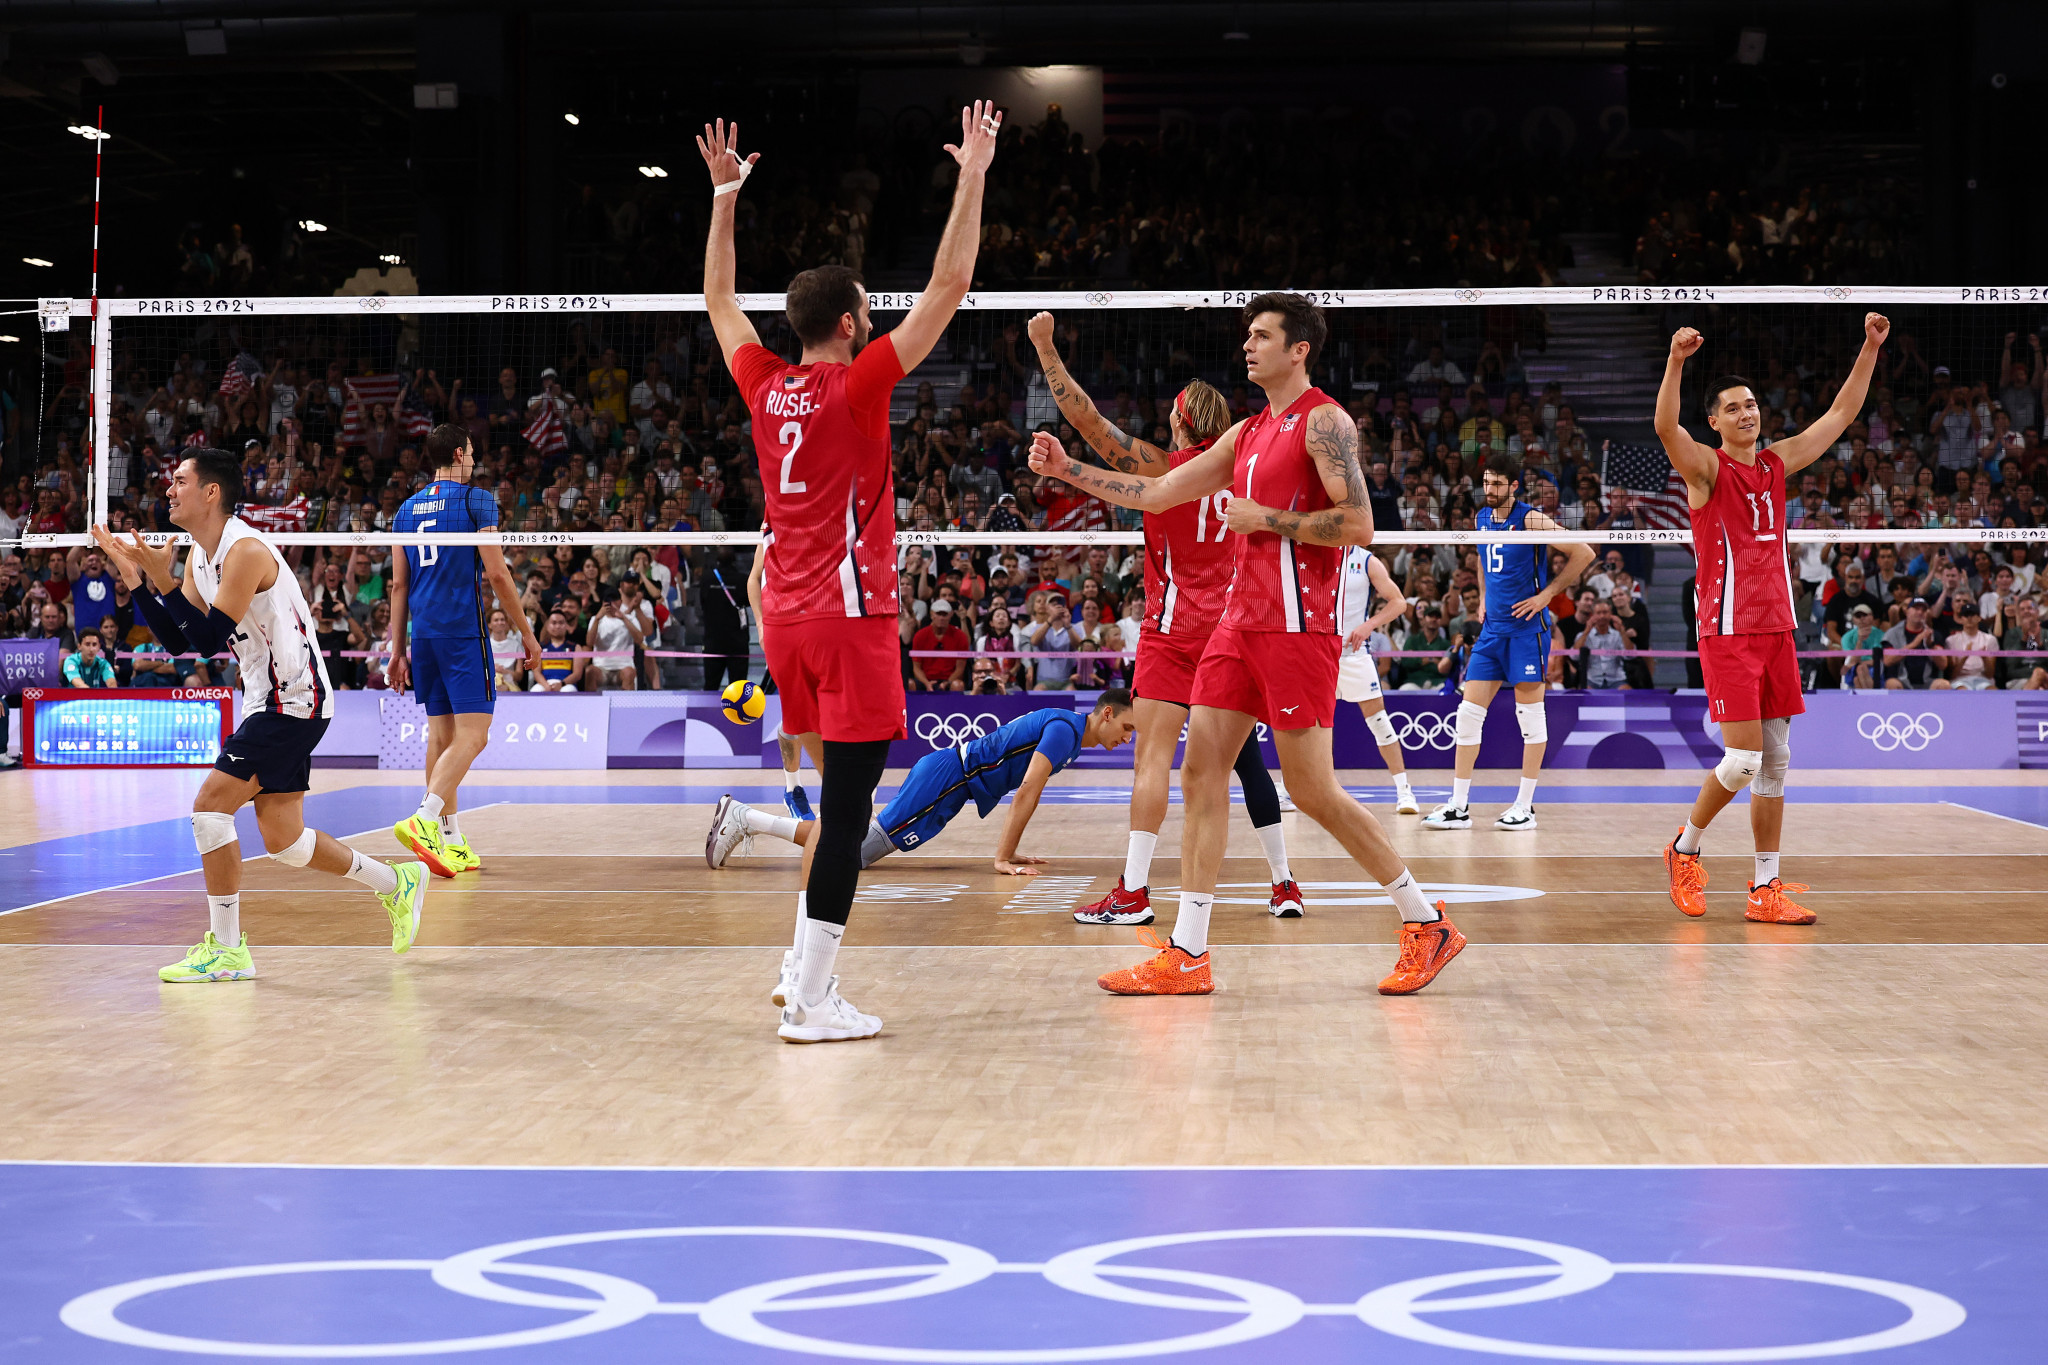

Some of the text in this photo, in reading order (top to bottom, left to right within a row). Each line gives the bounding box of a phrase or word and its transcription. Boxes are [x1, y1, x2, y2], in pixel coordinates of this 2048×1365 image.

[1662, 288, 1714, 300] 2024
[203, 300, 254, 313] 2024
[558, 296, 610, 309] 2024
[778, 421, 807, 494] 2
[1246, 453, 1259, 500] 1
[1746, 490, 1774, 531] 11
[542, 534, 574, 543] 2024
[1650, 532, 1683, 541] 2024
[1486, 543, 1504, 573] 15
[6, 666, 45, 680] 2024
[185, 688, 231, 700] OMEGA
[1715, 699, 1725, 715] 11
[61, 715, 77, 724] ITA
[127, 715, 139, 724] 24
[176, 714, 183, 724] 0
[206, 714, 214, 724] 2
[505, 722, 588, 743] 2024
[58, 741, 78, 751] USA
[111, 741, 124, 751] 30
[176, 741, 183, 750] 0
[191, 741, 199, 750] 6
[902, 831, 920, 847] 19
